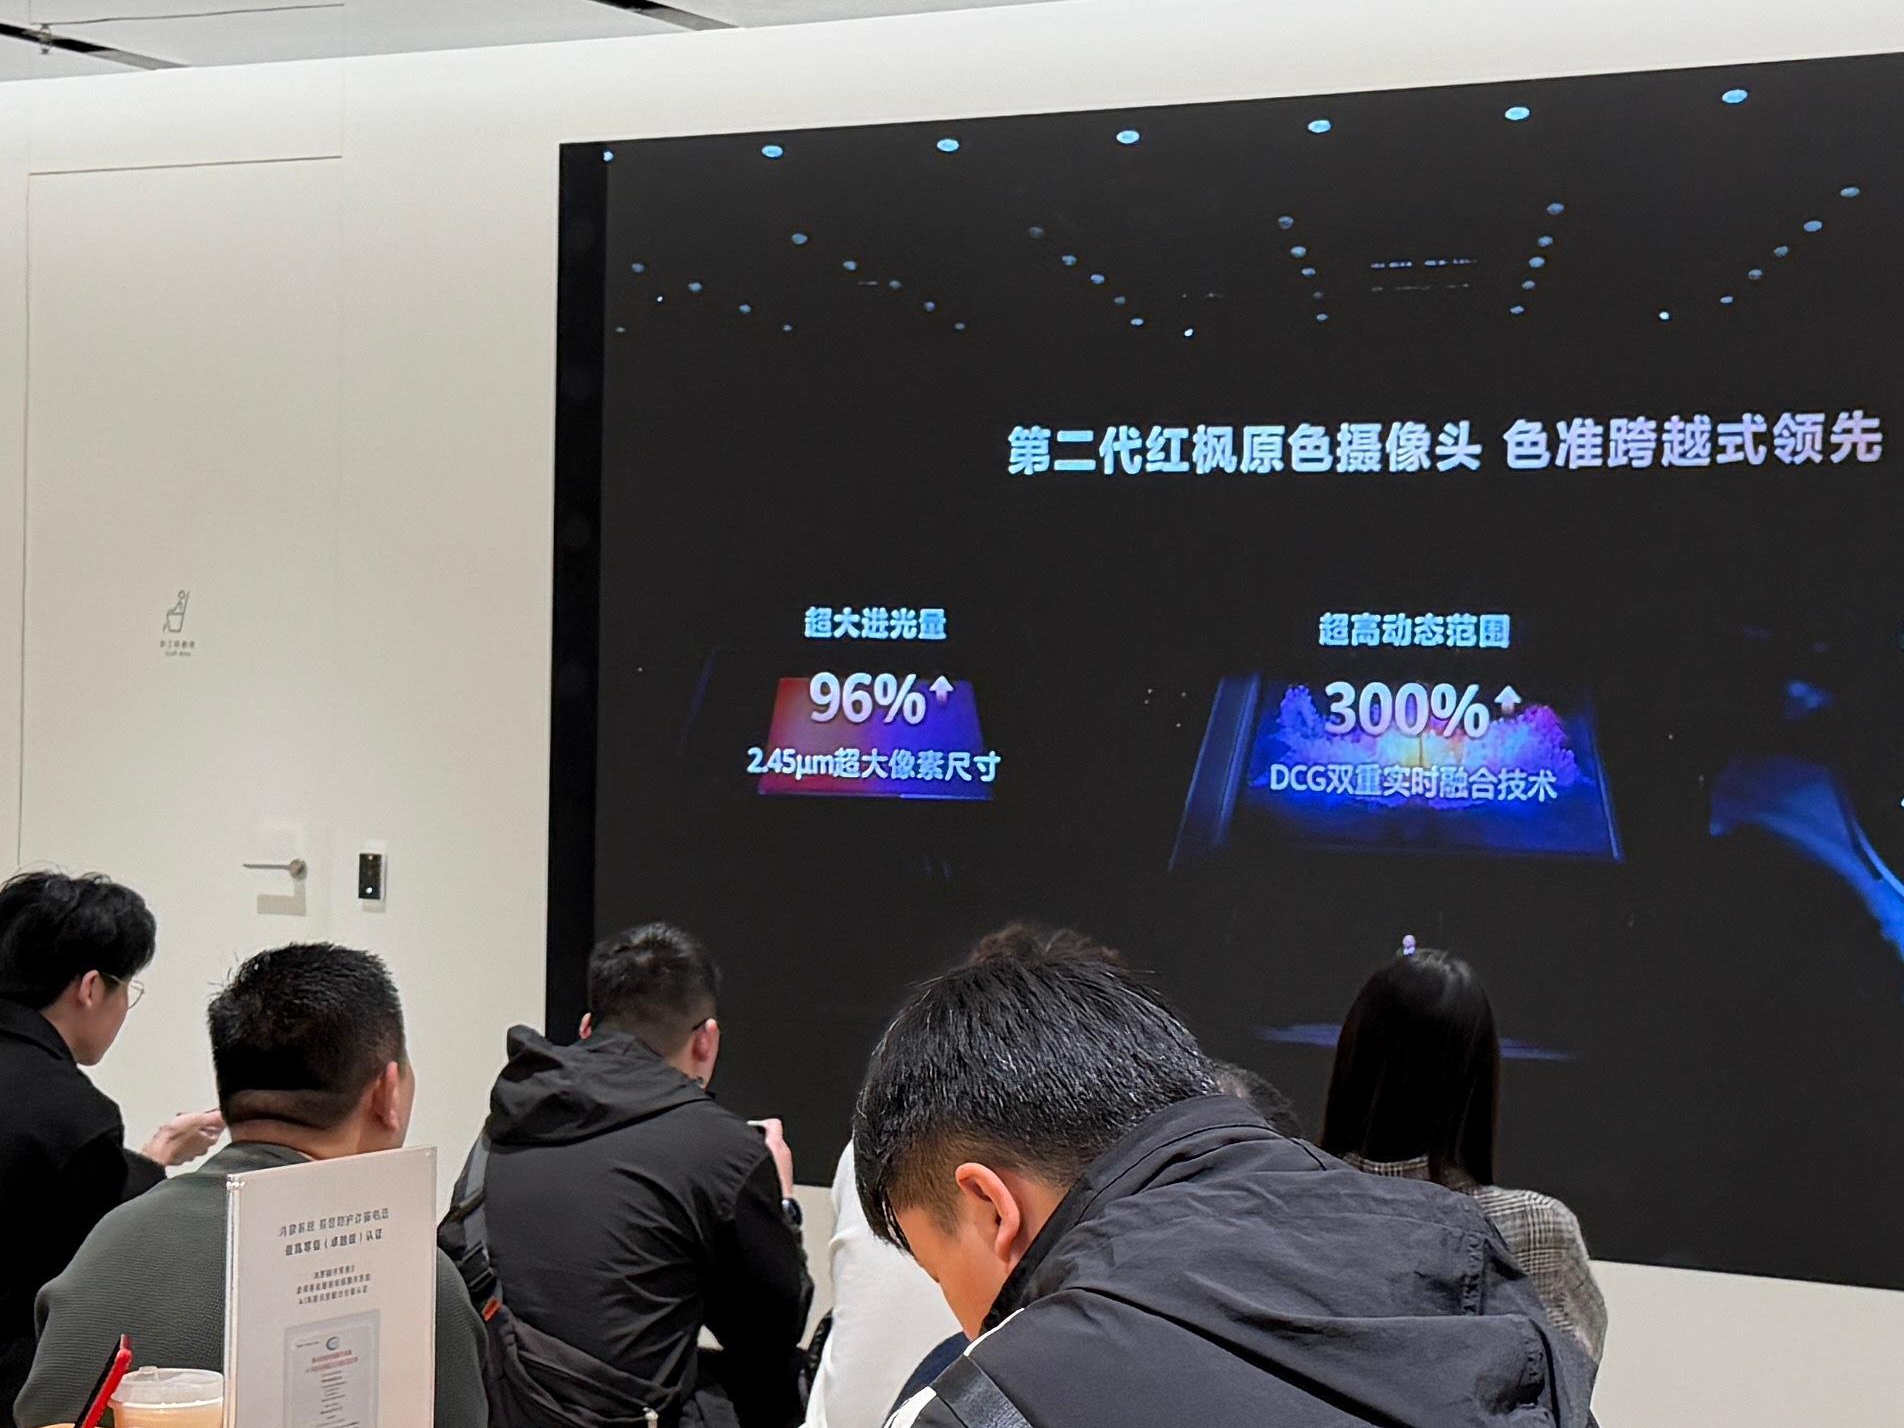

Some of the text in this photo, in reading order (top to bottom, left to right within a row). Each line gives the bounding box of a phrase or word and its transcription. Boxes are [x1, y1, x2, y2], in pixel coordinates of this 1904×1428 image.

[1007, 410, 1885, 476] 第二代红枫原色摄像头 色准跨越式领先
[803, 605, 948, 641] 超大进光量
[1318, 611, 1511, 650] 超高动态范围
[809, 671, 927, 725] 96%
[1323, 680, 1491, 739] 300%
[1269, 762, 1558, 802] DCG双重实时融合技术
